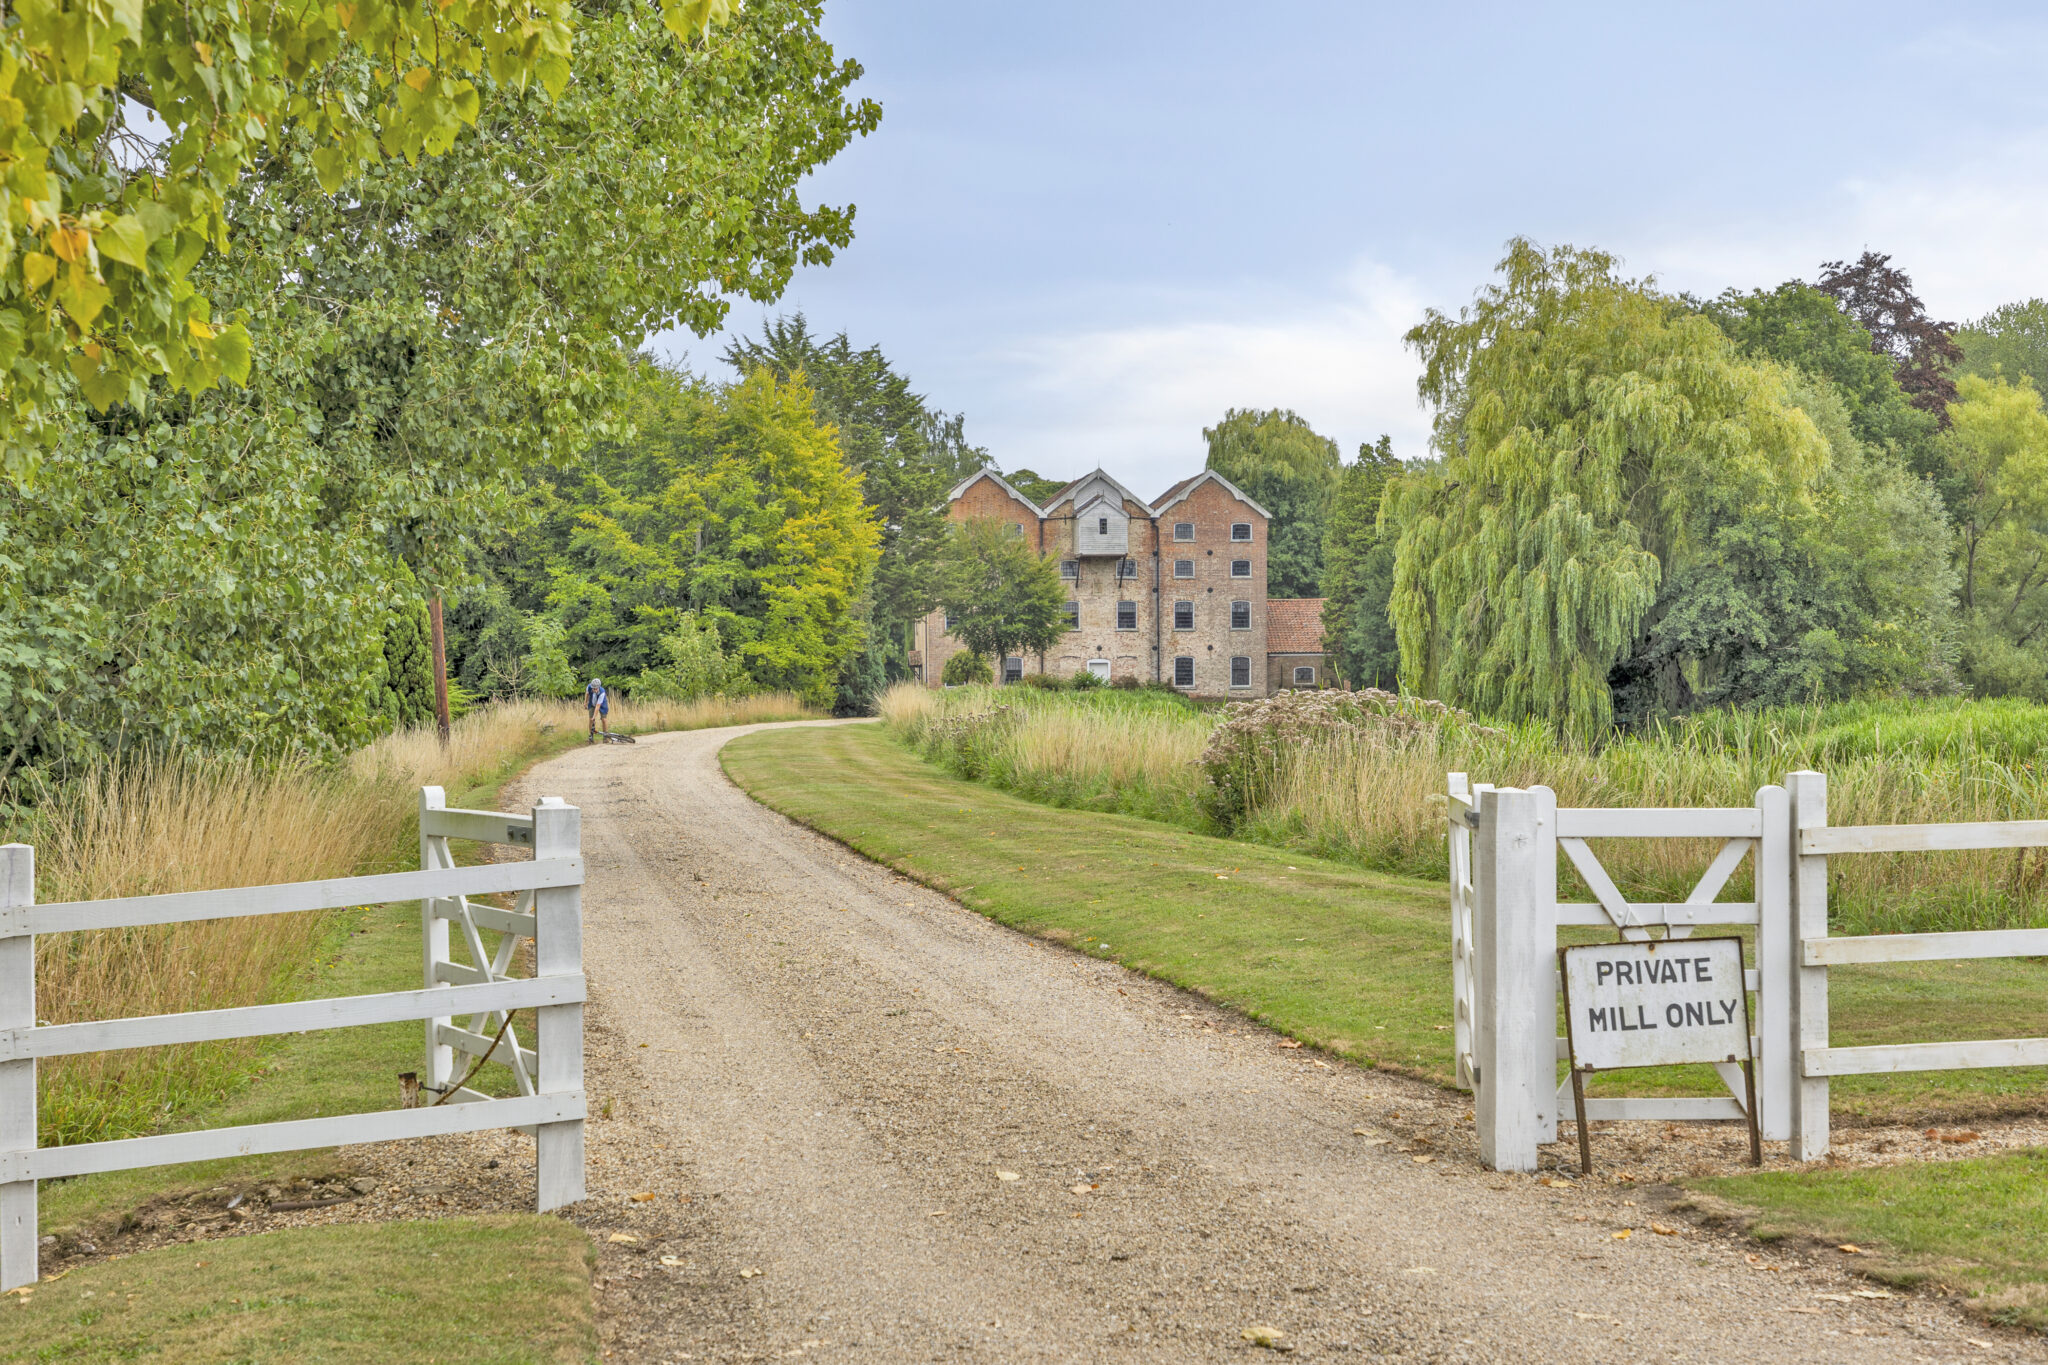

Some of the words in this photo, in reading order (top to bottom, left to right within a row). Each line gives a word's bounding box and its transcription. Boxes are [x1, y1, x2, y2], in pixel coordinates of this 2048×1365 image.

[1596, 957, 1713, 986] PRIVATE
[1588, 1005, 1658, 1032] MILL
[1665, 999, 1737, 1028] ONLY
